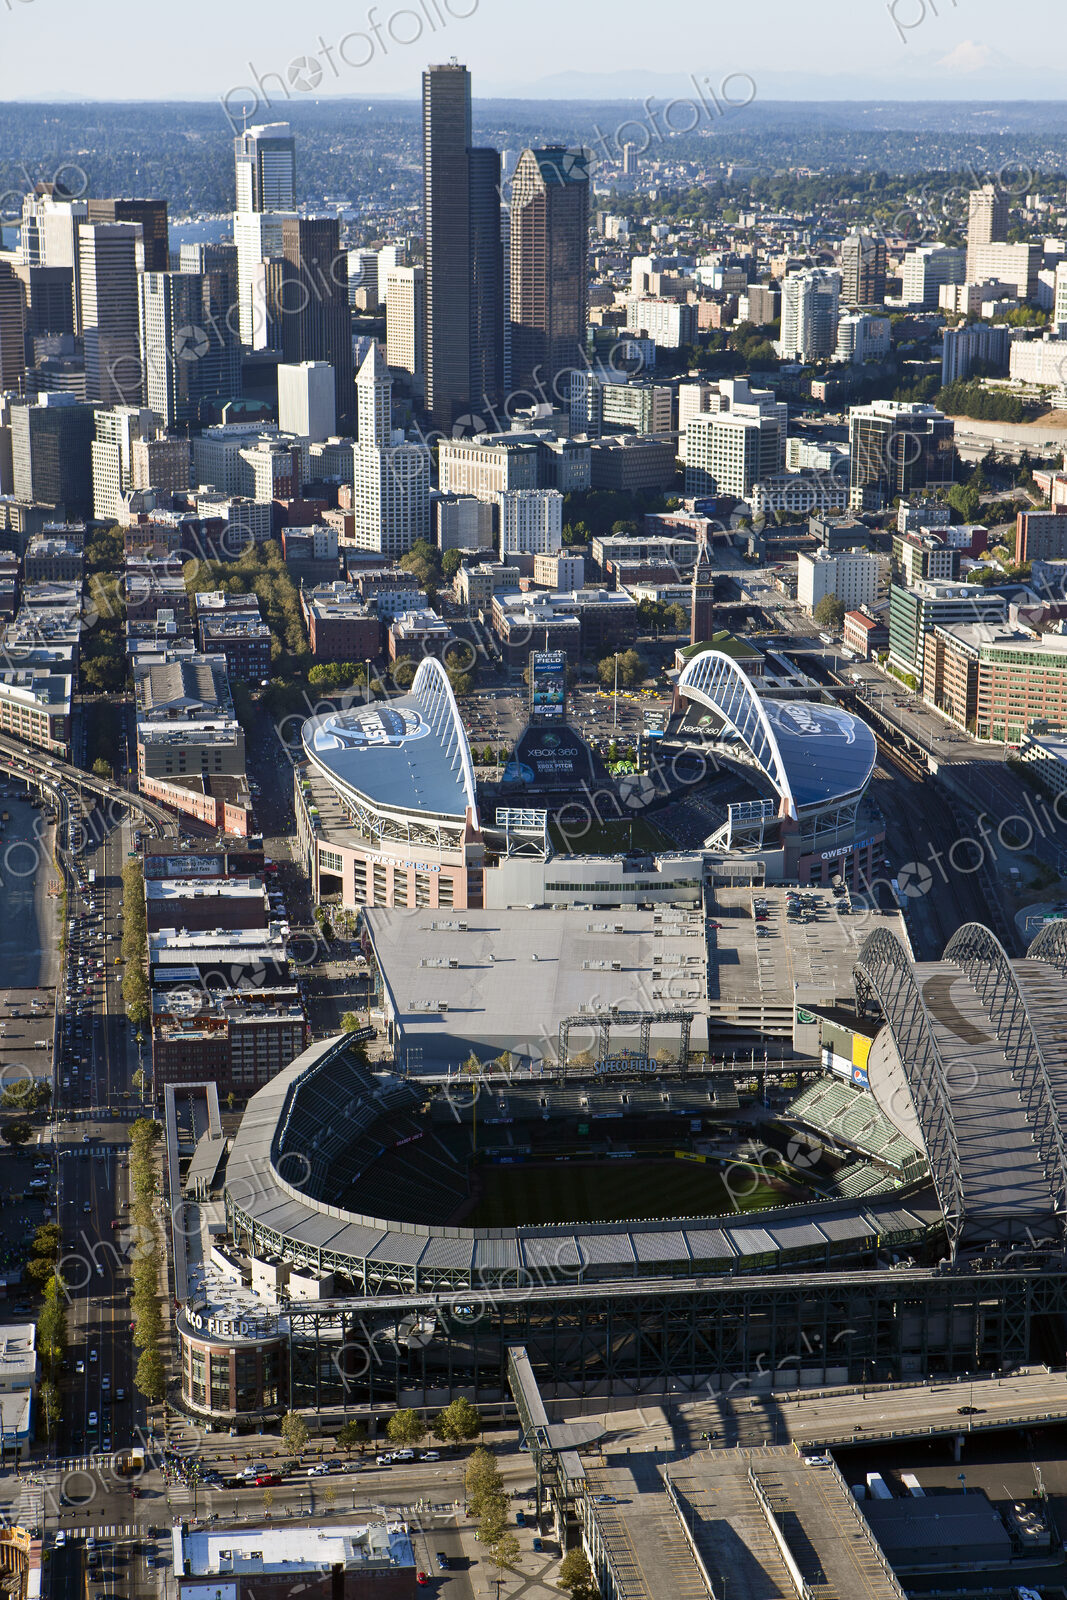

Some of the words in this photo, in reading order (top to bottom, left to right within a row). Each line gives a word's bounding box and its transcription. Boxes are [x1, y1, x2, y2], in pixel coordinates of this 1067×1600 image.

[681, 725, 703, 733] XBOX
[528, 748, 557, 757] XBOX
[821, 844, 853, 860] QWEST
[853, 837, 875, 850] FIELD
[364, 853, 404, 867] QWEST
[404, 861, 441, 873] FIELD
[593, 1059, 628, 1075] SAFECO
[630, 1058, 657, 1073] FIELD
[207, 1318, 249, 1335] FIELD
